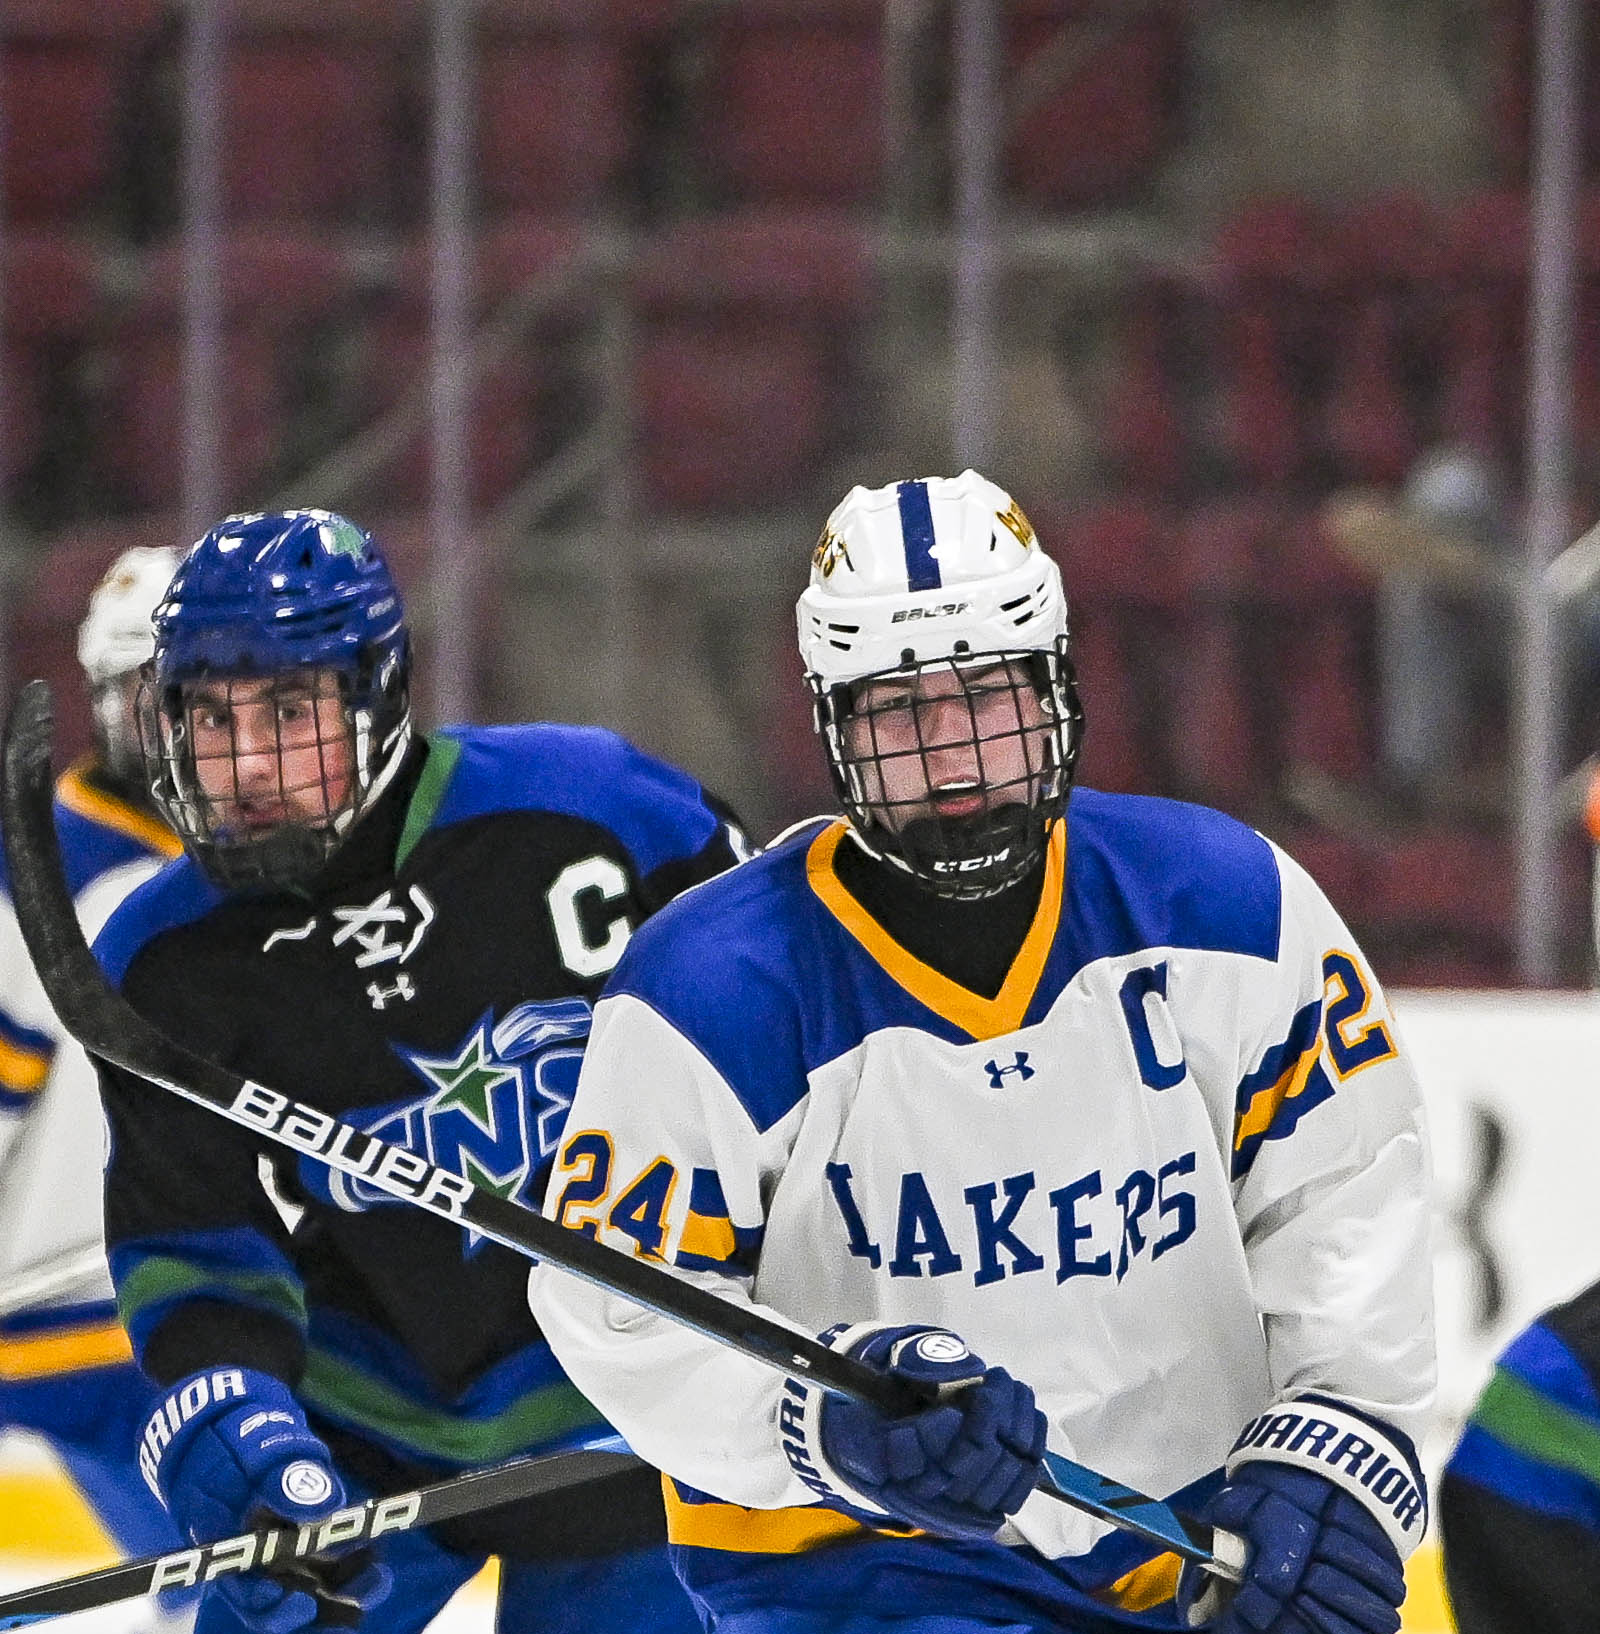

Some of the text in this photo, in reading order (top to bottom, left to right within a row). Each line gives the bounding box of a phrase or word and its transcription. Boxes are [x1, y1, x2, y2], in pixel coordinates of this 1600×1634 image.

[546, 854, 633, 978] C
[1119, 959, 1187, 1092] C
[228, 1079, 477, 1218] BAUER
[551, 1128, 681, 1270] 24
[825, 1151, 1197, 1288] LAKERS
